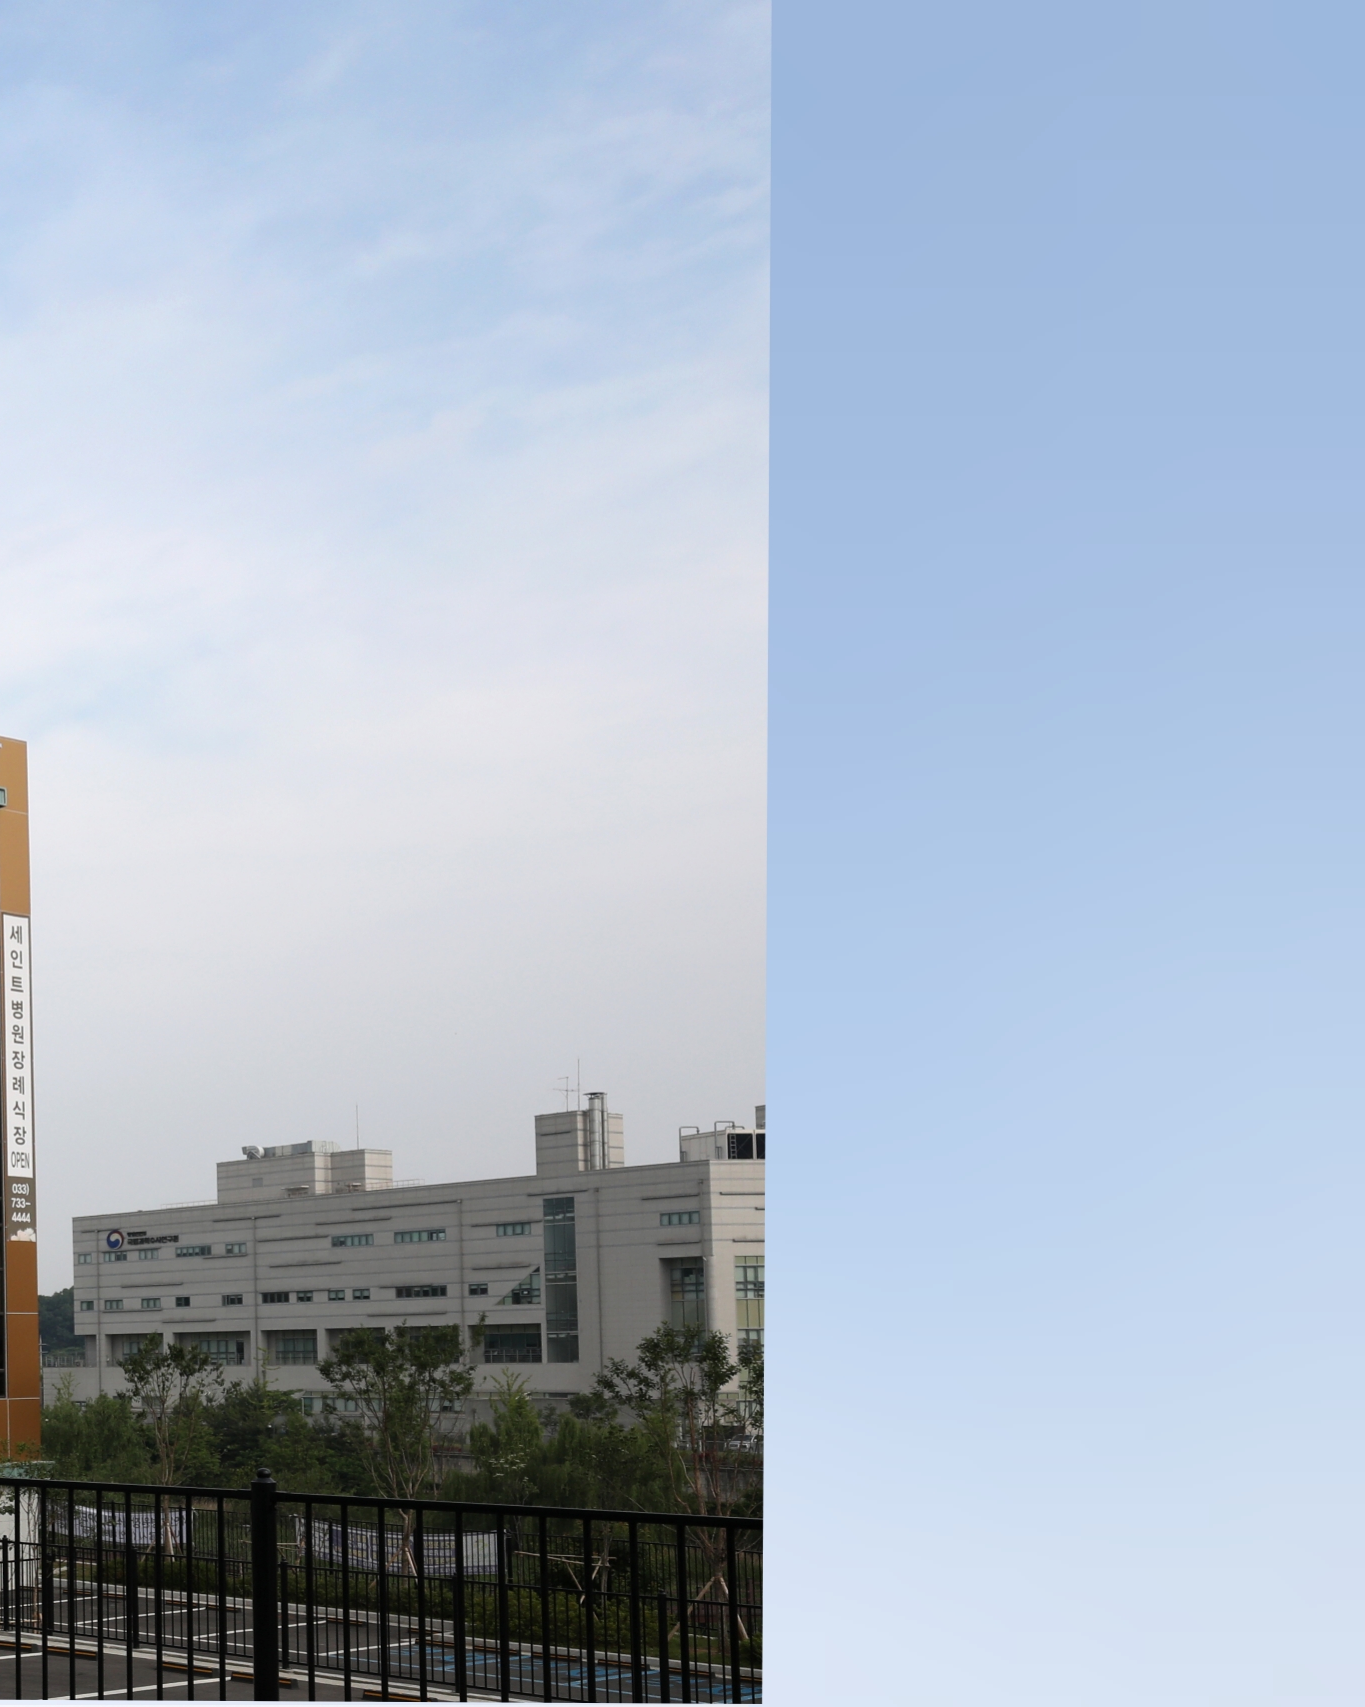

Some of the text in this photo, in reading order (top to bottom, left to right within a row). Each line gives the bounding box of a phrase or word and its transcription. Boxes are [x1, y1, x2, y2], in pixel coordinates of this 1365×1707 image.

[10, 926, 27, 1145] 세인트병원장례식장
[11, 1151, 30, 1169] OPEN
[12, 1183, 29, 1195] 033)
[11, 1197, 31, 1208] 733-
[11, 1212, 31, 1223] 4444
